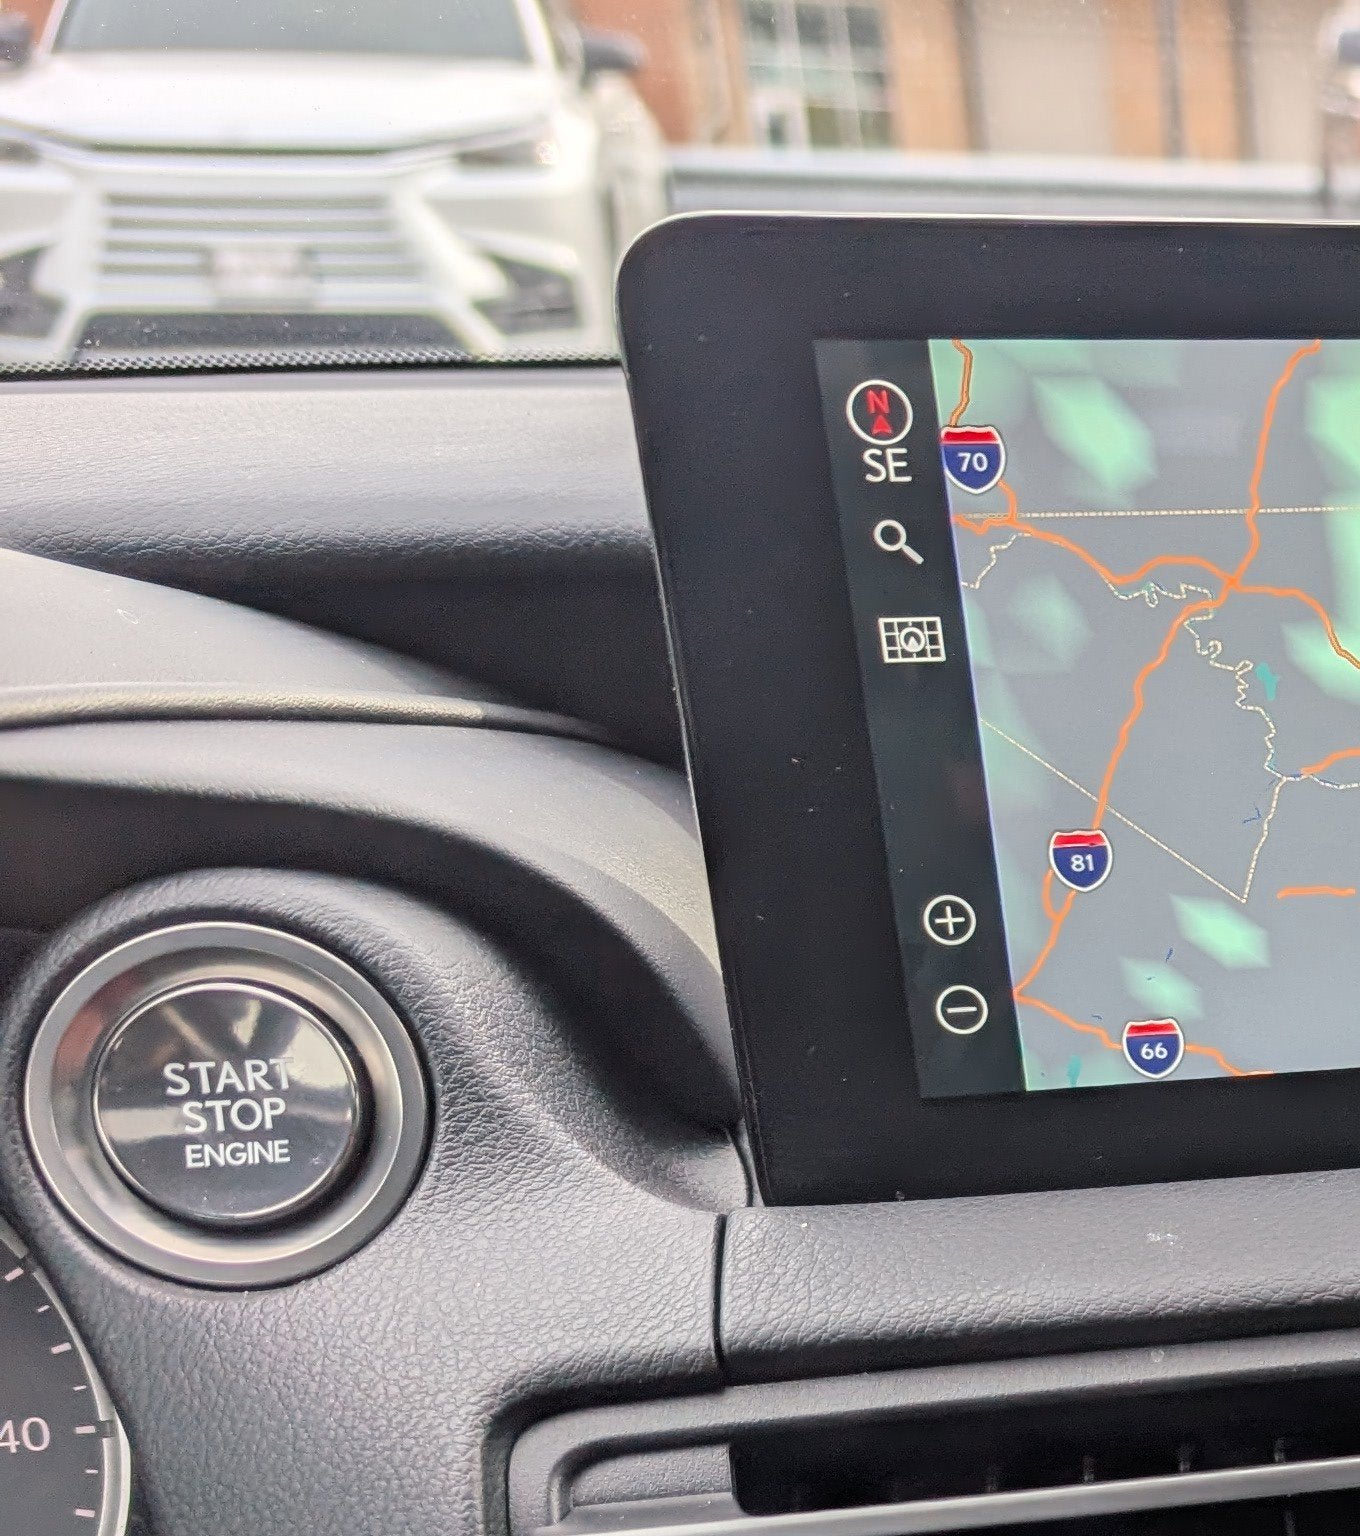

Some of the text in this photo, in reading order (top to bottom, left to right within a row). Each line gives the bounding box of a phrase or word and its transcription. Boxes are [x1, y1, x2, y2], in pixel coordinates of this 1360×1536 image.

[866, 389, 890, 414] N
[863, 448, 912, 483] SE
[957, 452, 988, 473] 70
[1069, 855, 1095, 873] 81
[1140, 1043, 1168, 1061] 66
[163, 1056, 294, 1097] START
[181, 1097, 286, 1134] STOP
[184, 1138, 291, 1169] ENGINE
